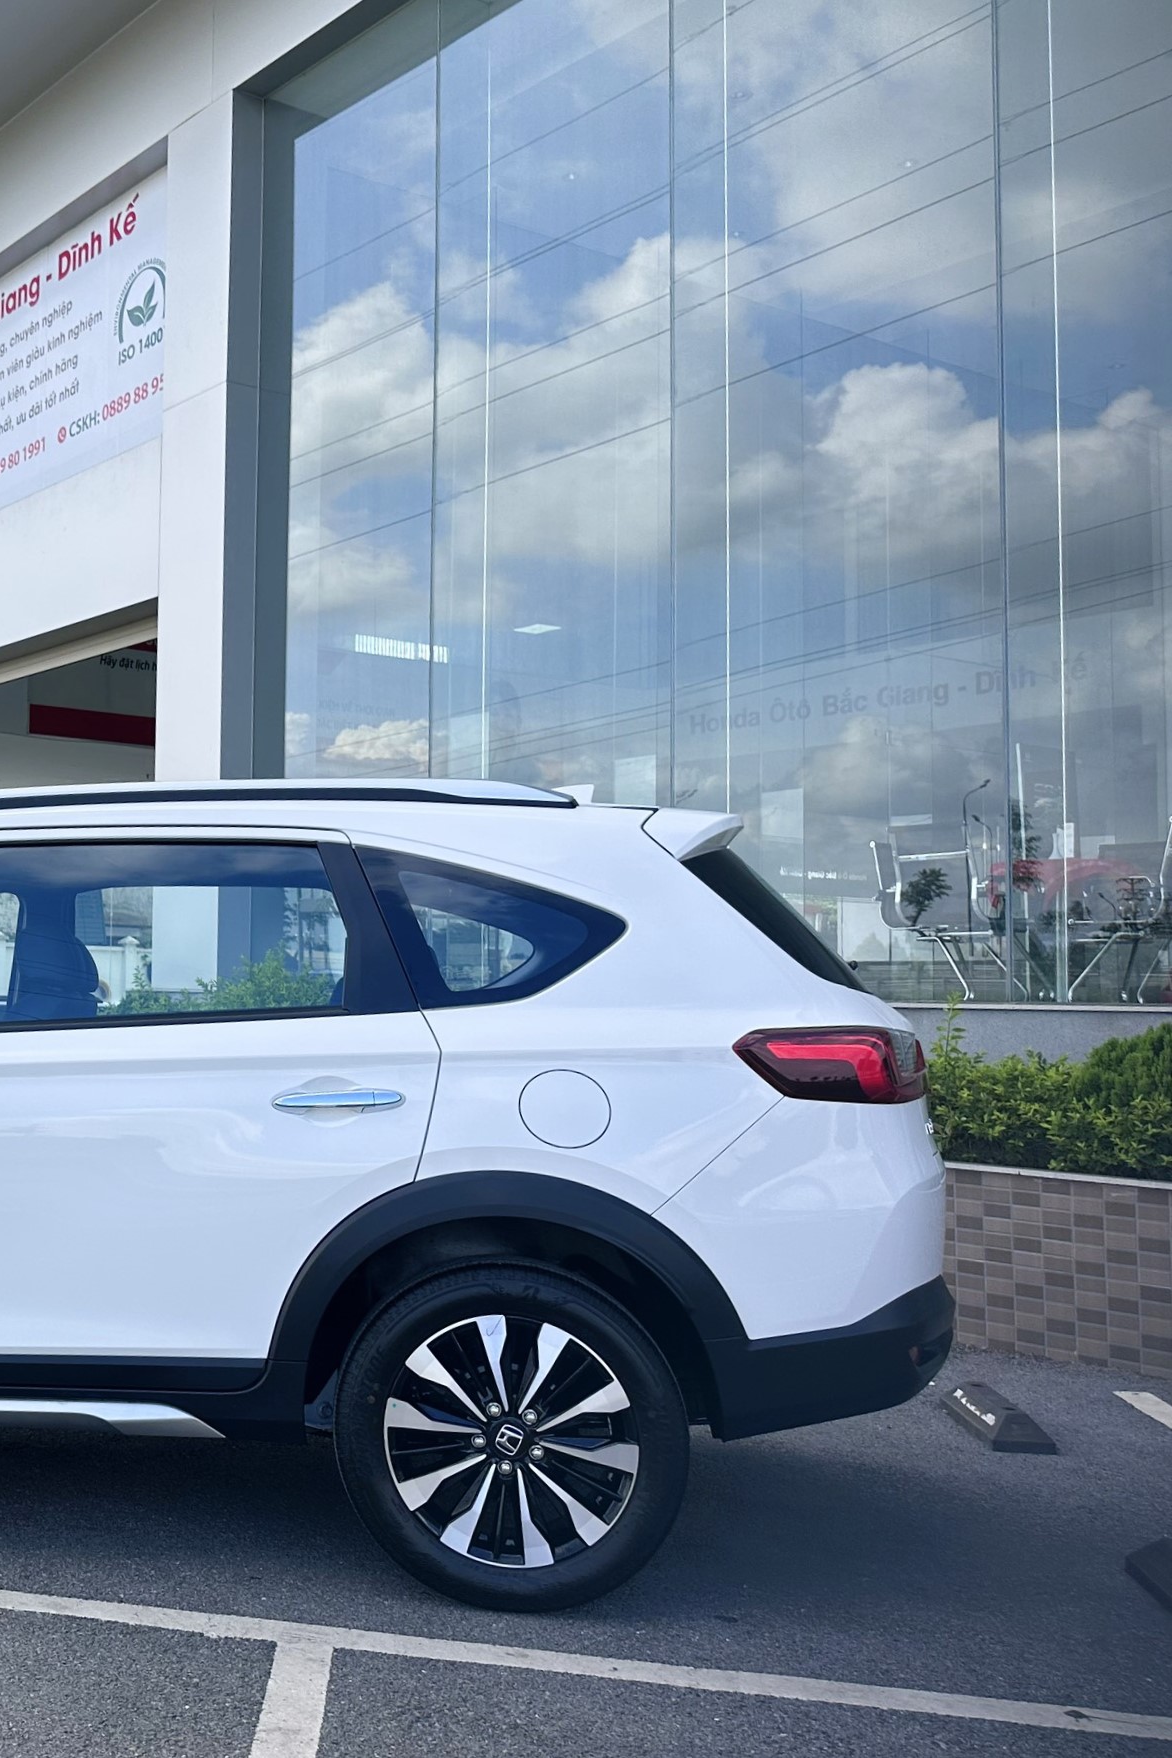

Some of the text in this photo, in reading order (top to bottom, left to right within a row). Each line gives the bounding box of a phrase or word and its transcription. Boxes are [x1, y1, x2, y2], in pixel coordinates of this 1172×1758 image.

[57, 230, 103, 281] Dĩnh
[108, 192, 141, 248] Kế
[6, 358, 24, 377] viên
[25, 345, 45, 369] giàu
[47, 333, 66, 353] kinh
[67, 310, 103, 341] nghiệm
[9, 321, 40, 348] chuyên
[41, 300, 73, 329] nghiệp
[117, 325, 166, 366] ISO 1400
[28, 367, 53, 391] chính
[55, 353, 79, 376] hãng
[59, 376, 80, 400] nhất
[68, 410, 101, 438] CSKH:
[101, 390, 131, 421] 0889
[133, 381, 149, 405] 88
[7, 449, 21, 470] 80
[21, 436, 47, 464] 1991
[100, 654, 118, 669] Hãy
[119, 657, 134, 671] đặt
[135, 658, 150, 672] lịch
[689, 706, 761, 735] Honda
[769, 697, 811, 723] Ôtô
[822, 687, 868, 717] Bắc
[876, 681, 950, 708] Giang
